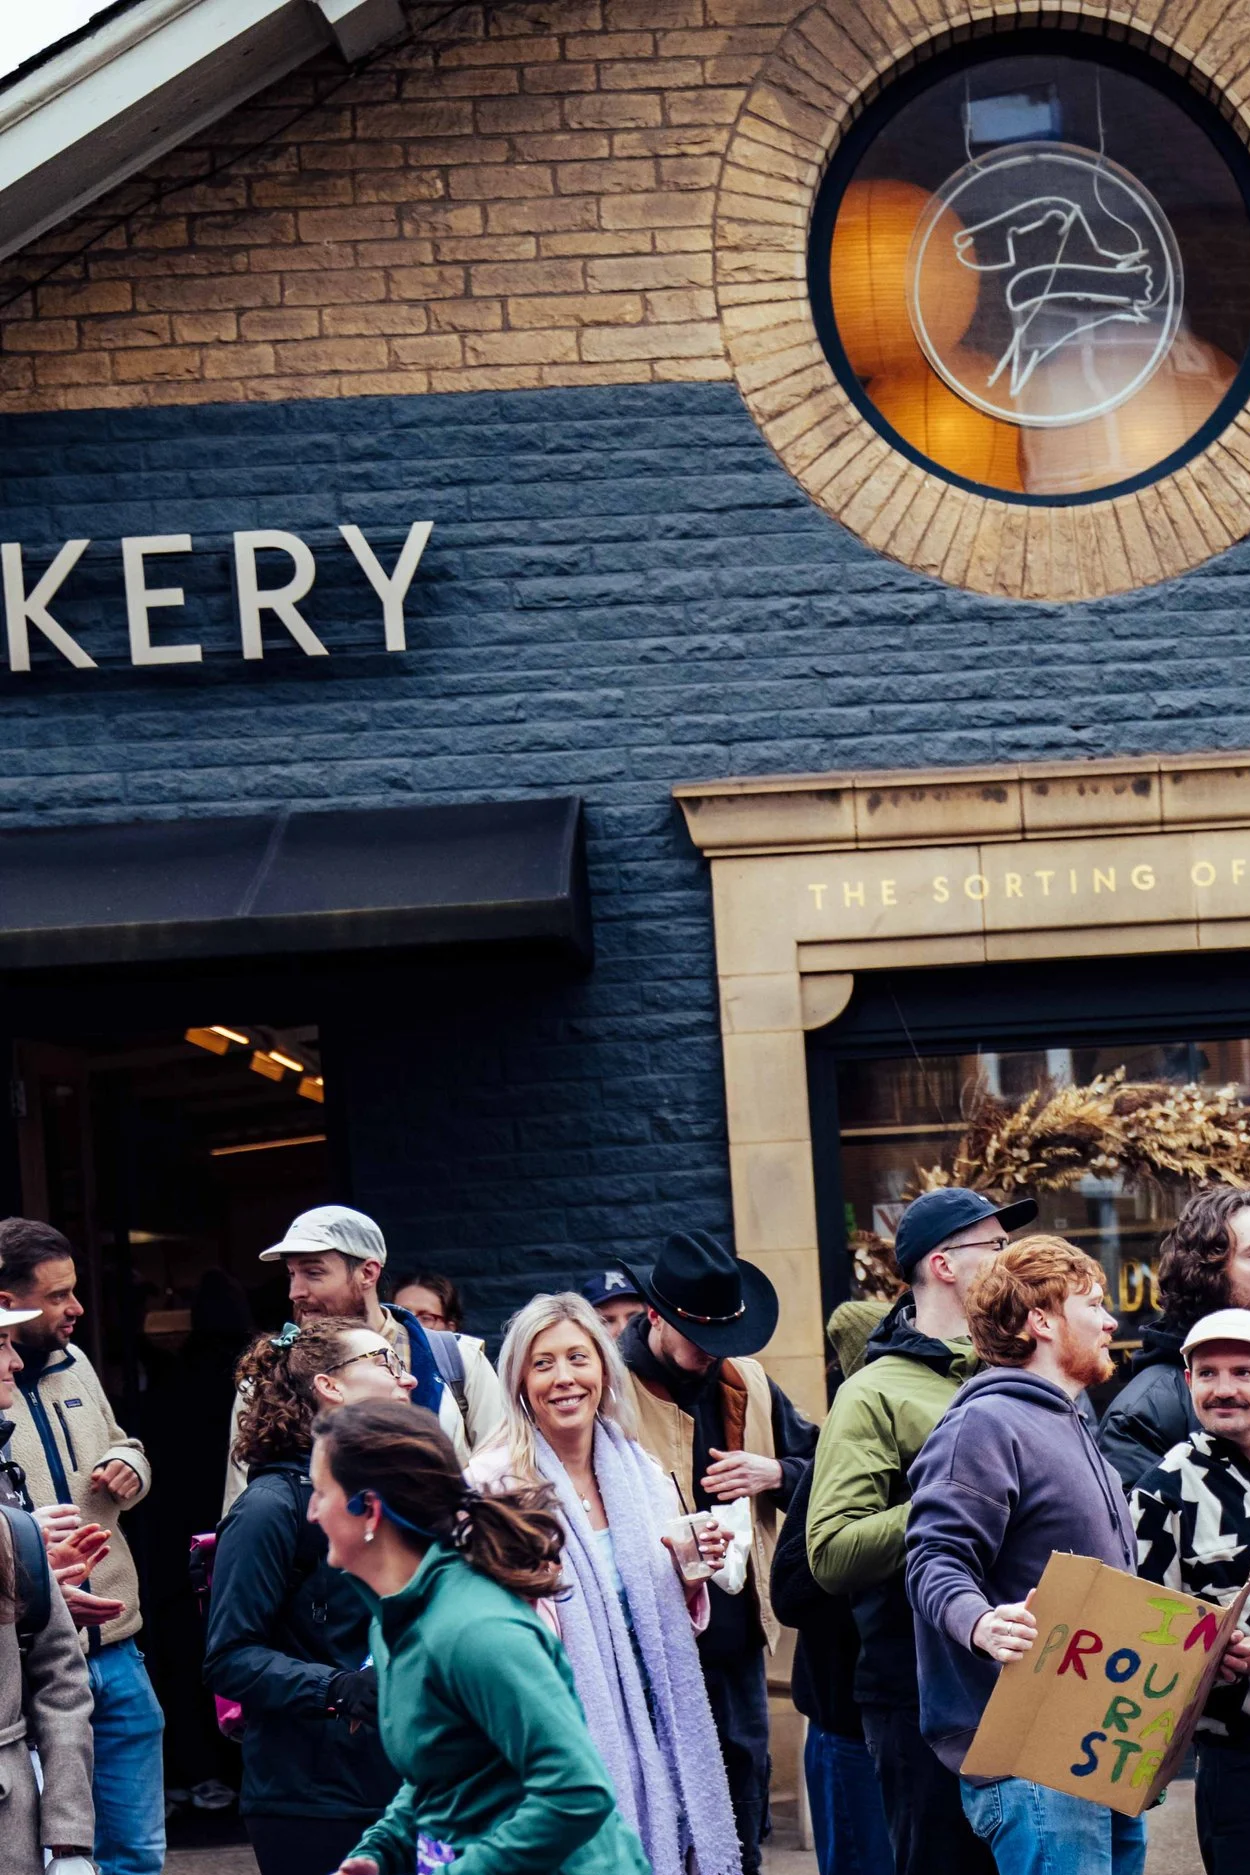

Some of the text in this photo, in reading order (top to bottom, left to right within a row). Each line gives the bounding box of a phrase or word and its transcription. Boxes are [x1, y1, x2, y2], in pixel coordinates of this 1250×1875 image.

[0, 520, 435, 672] KERY
[807, 879, 898, 911] THE
[932, 863, 1156, 904] SORTING
[1033, 1622, 1205, 1702] PROU
